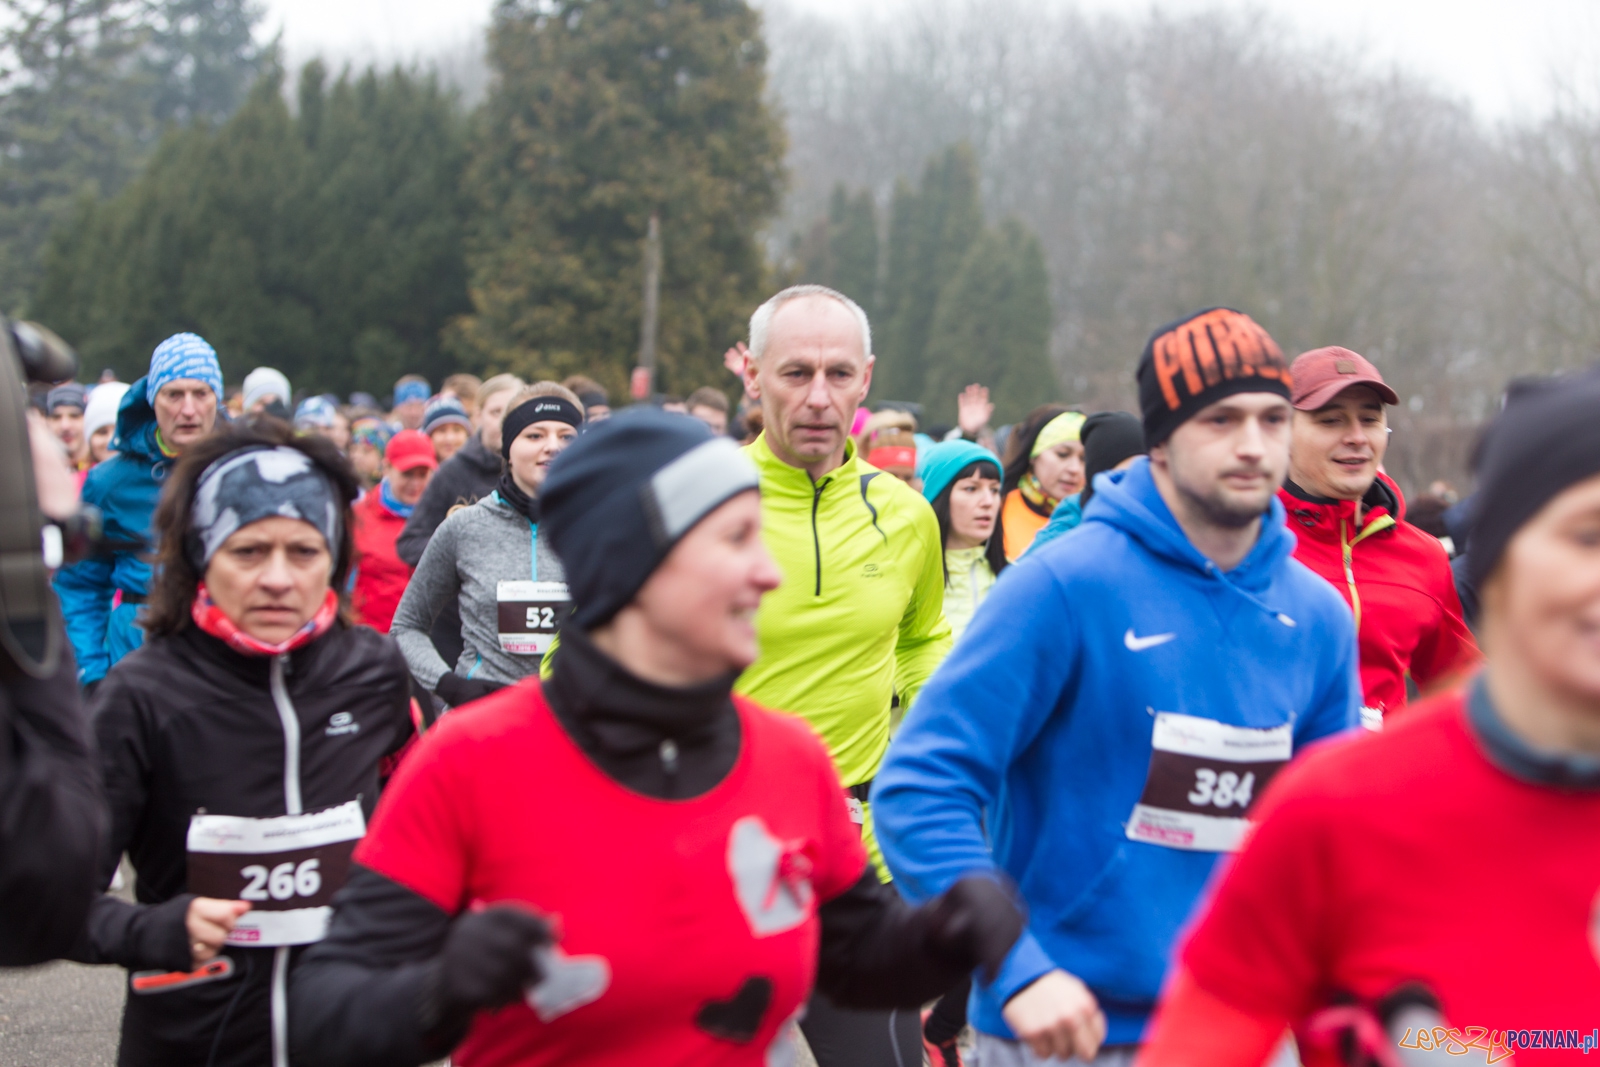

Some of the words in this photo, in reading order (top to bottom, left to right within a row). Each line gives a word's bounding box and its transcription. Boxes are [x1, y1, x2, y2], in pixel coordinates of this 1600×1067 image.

[526, 606, 557, 628] 52
[1188, 768, 1255, 808] 384
[239, 858, 322, 900] 266
